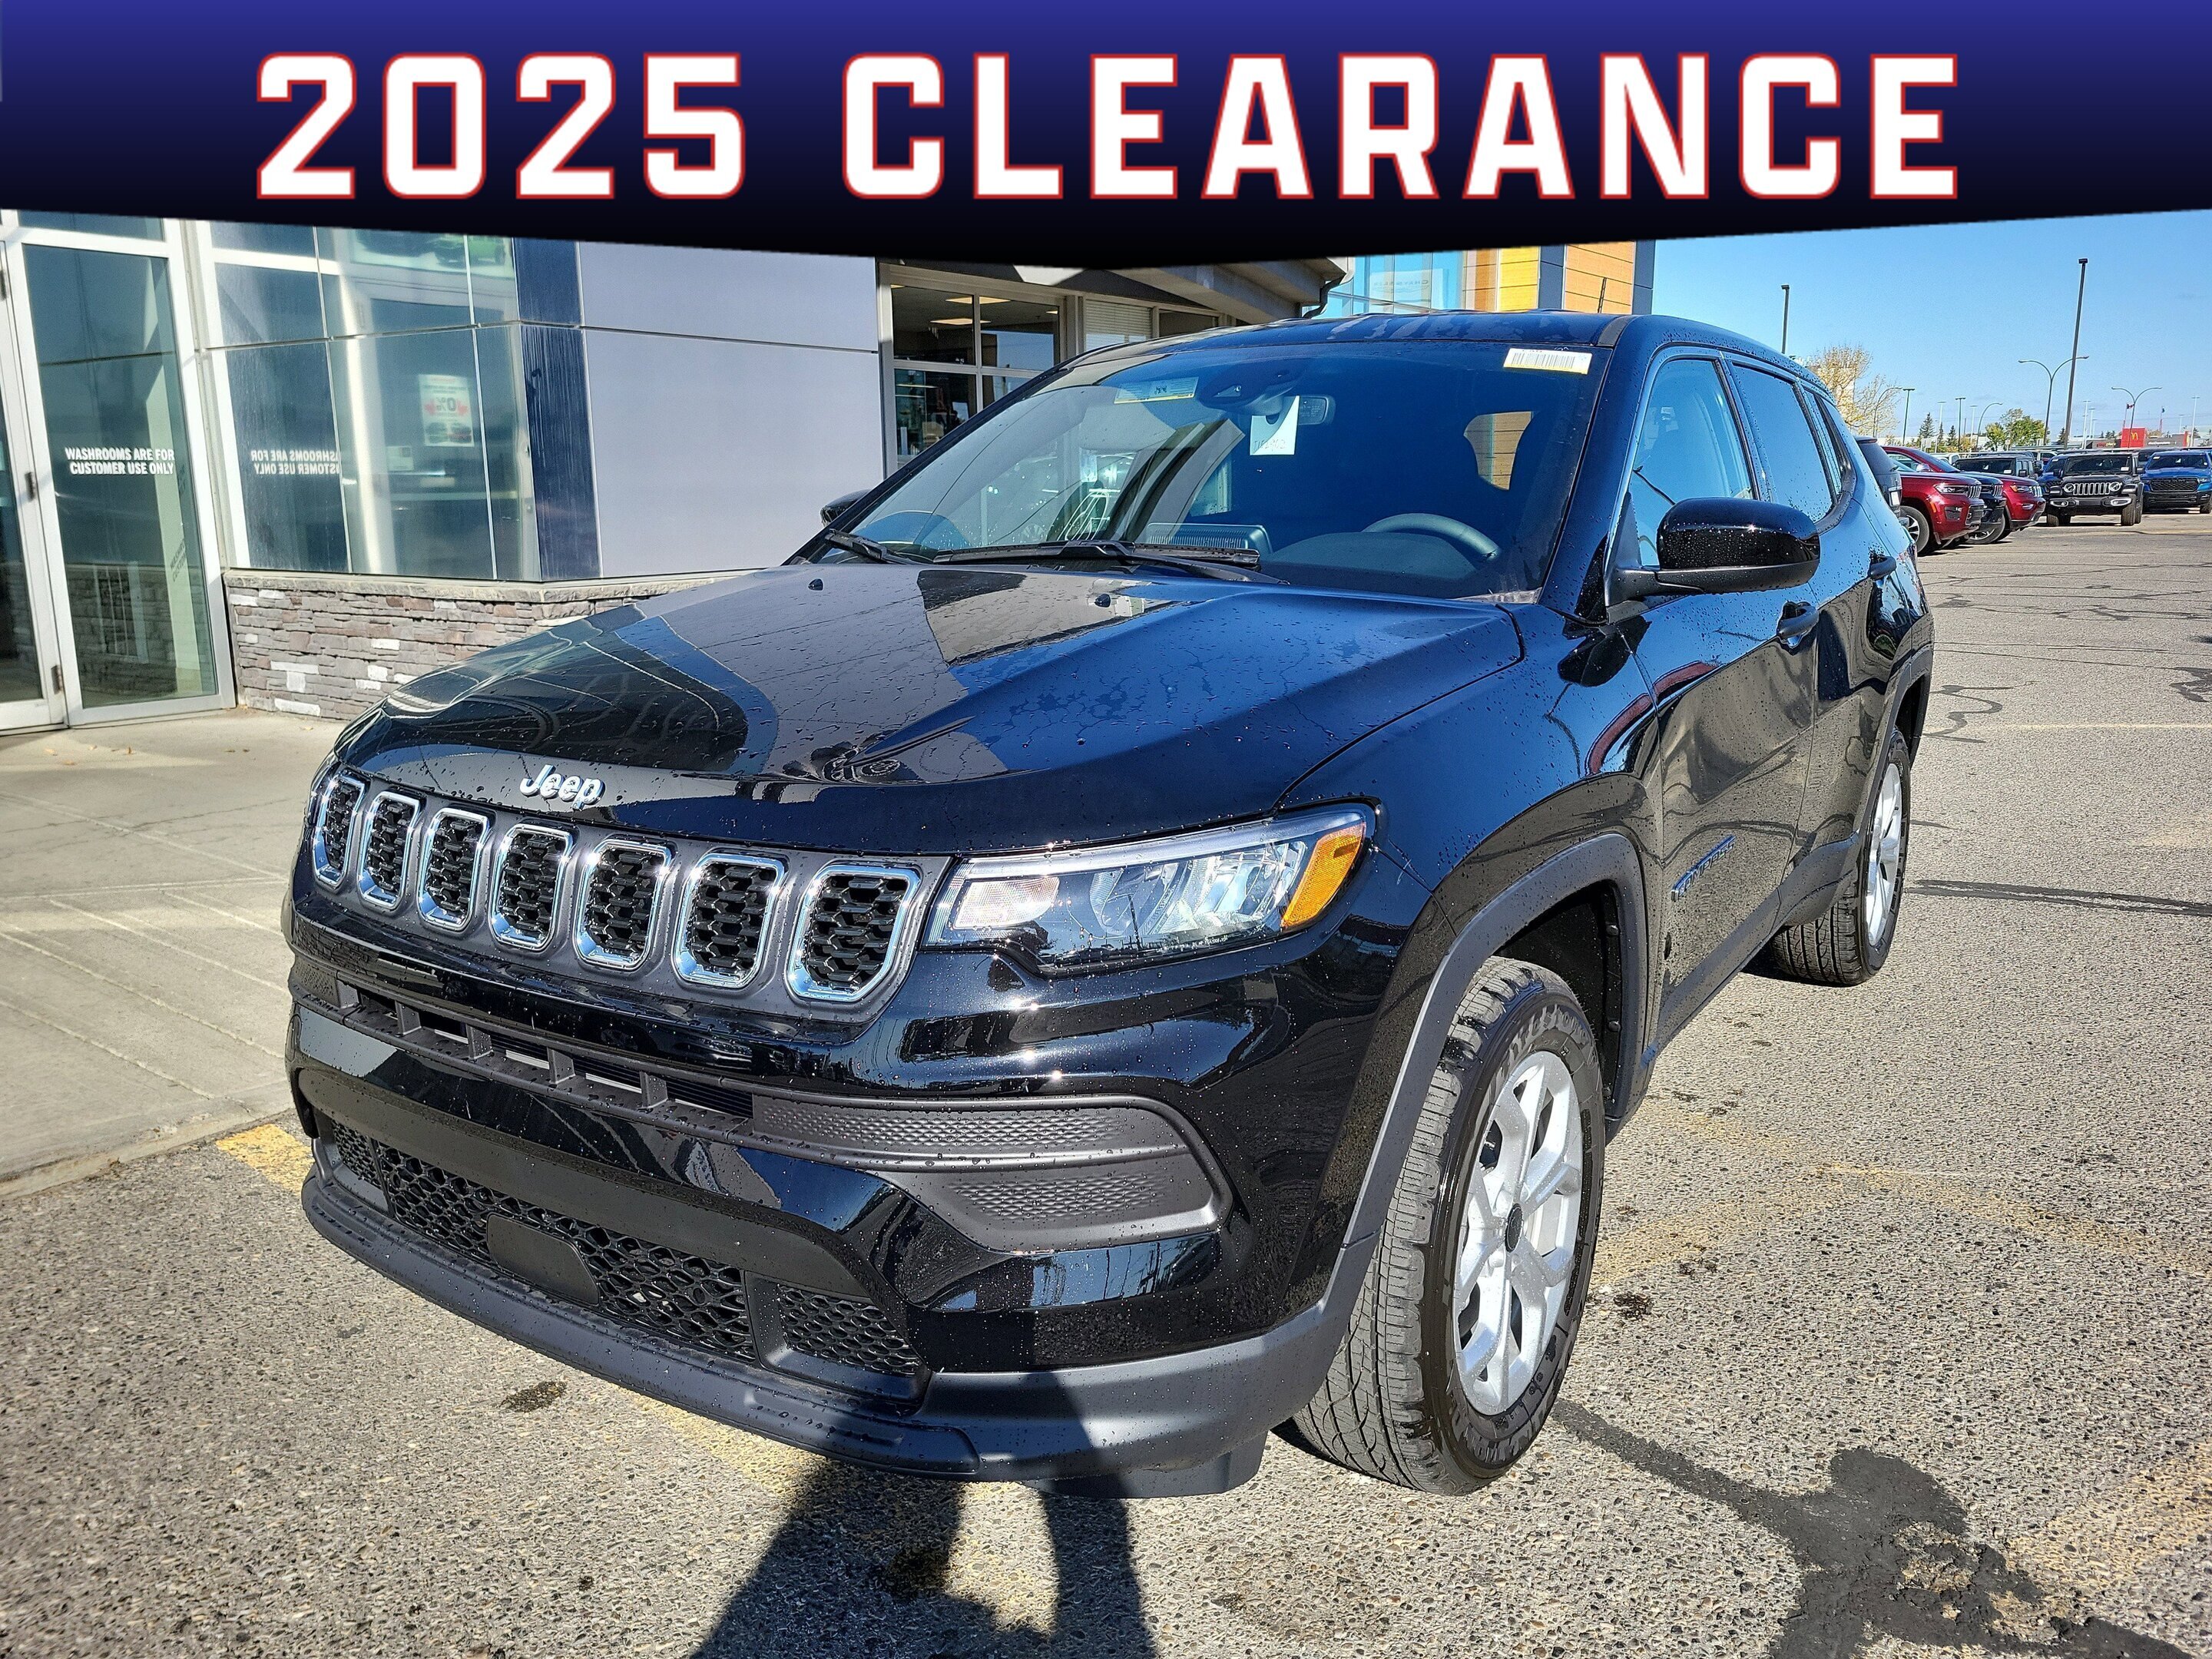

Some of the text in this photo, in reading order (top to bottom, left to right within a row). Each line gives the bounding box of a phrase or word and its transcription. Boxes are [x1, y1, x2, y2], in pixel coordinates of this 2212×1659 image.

[65, 446, 175, 461] WASHROOMS ARE FOR
[69, 461, 174, 475] CUSTOMER USE ONLY
[519, 764, 605, 810] Jeep
